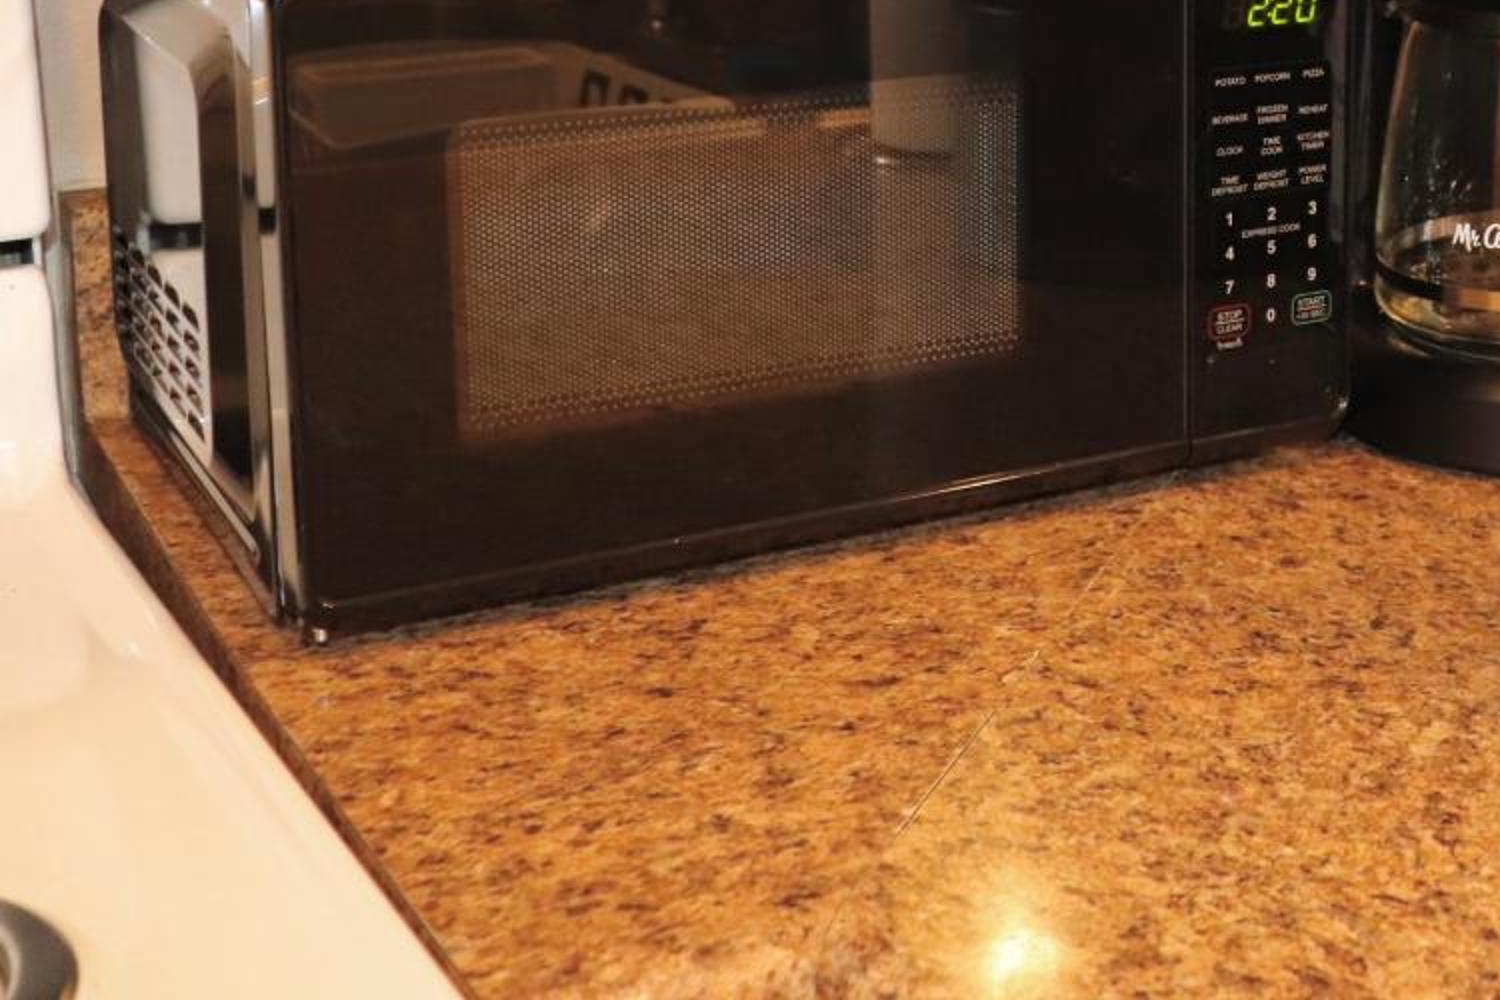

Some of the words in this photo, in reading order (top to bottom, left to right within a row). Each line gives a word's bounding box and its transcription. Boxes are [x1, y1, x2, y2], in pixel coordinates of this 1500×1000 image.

[1254, 72, 1291, 83] POPCORN
[1267, 206, 1277, 221] 2
[1308, 201, 1317, 215] 3
[1225, 212, 1234, 227] 1
[1307, 234, 1317, 248] 6
[1451, 222, 1481, 254] Mr.
[1225, 246, 1235, 260] 4
[1267, 240, 1276, 254] 5
[1266, 273, 1276, 288] 8
[1307, 267, 1317, 281] 9
[1225, 280, 1234, 294] 7
[1266, 308, 1275, 322] 0
